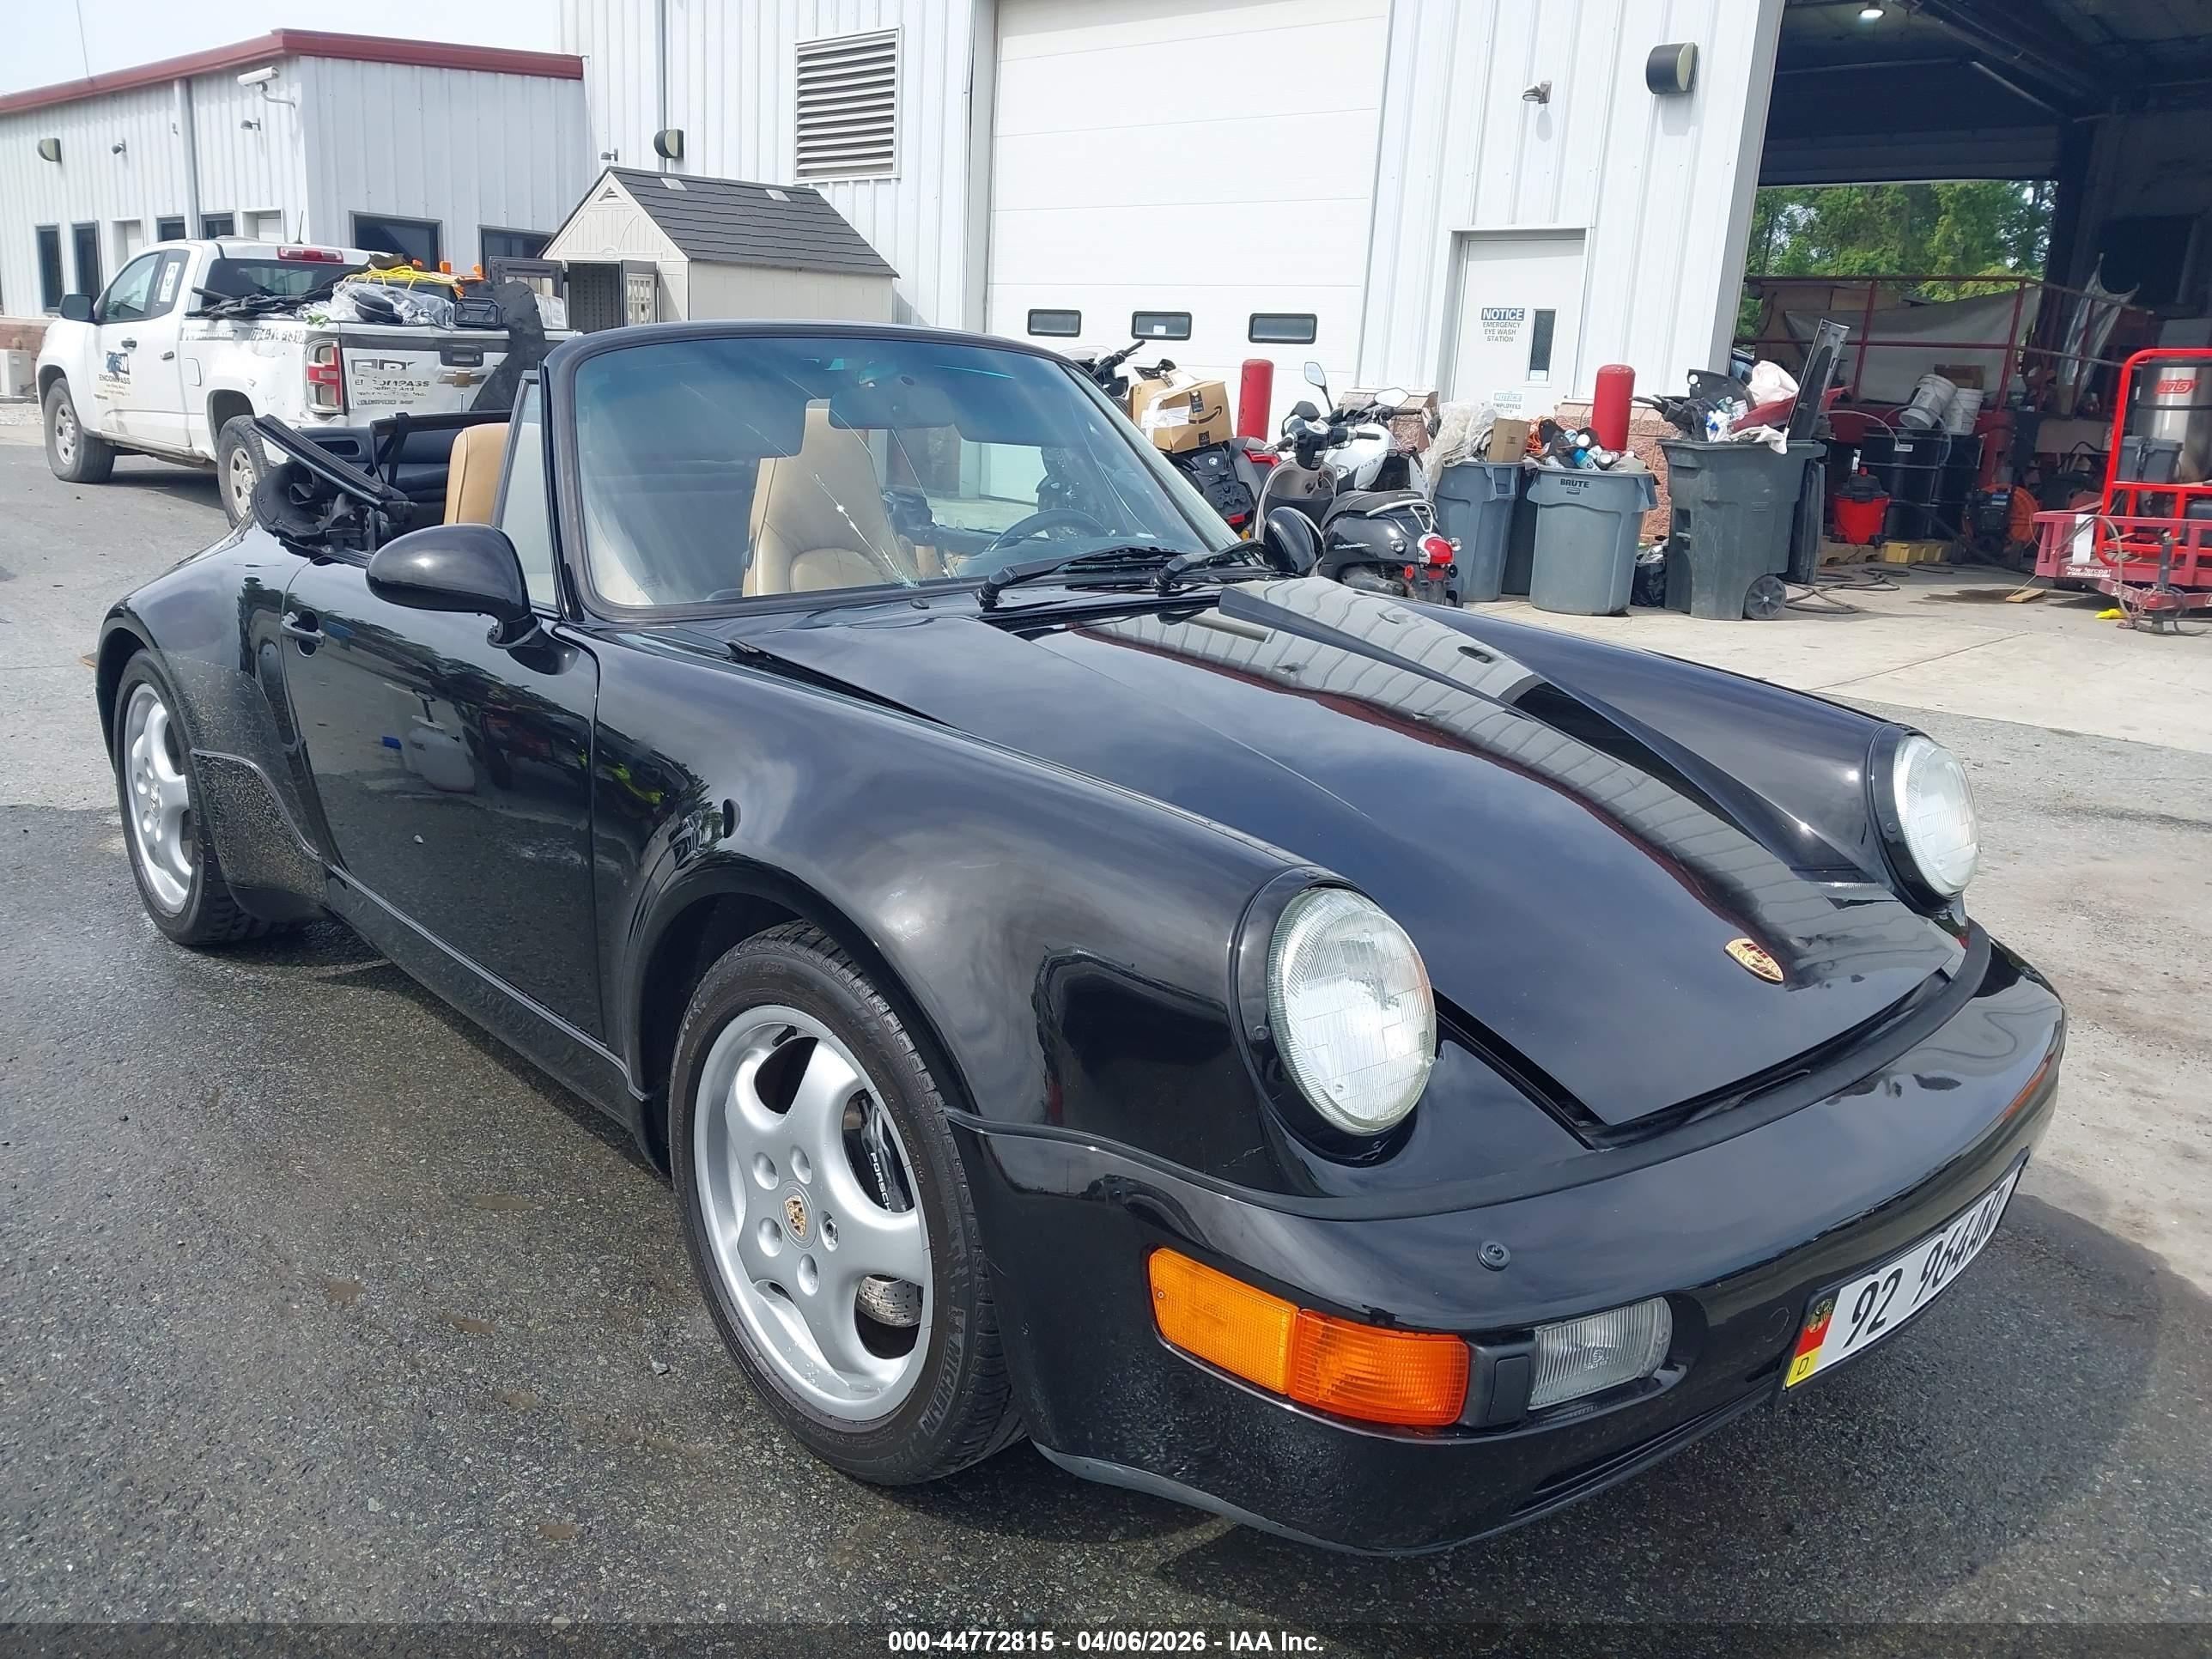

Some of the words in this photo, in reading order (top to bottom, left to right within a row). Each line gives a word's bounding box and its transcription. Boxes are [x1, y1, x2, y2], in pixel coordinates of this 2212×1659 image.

[1483, 309, 1523, 319] NOTICE
[1560, 477, 1590, 489] BRUTE
[870, 1152, 892, 1212] PORSCH
[1843, 1268, 1904, 1349] 92
[1796, 1356, 1809, 1376] D
[919, 1337, 962, 1437] MICHELIN
